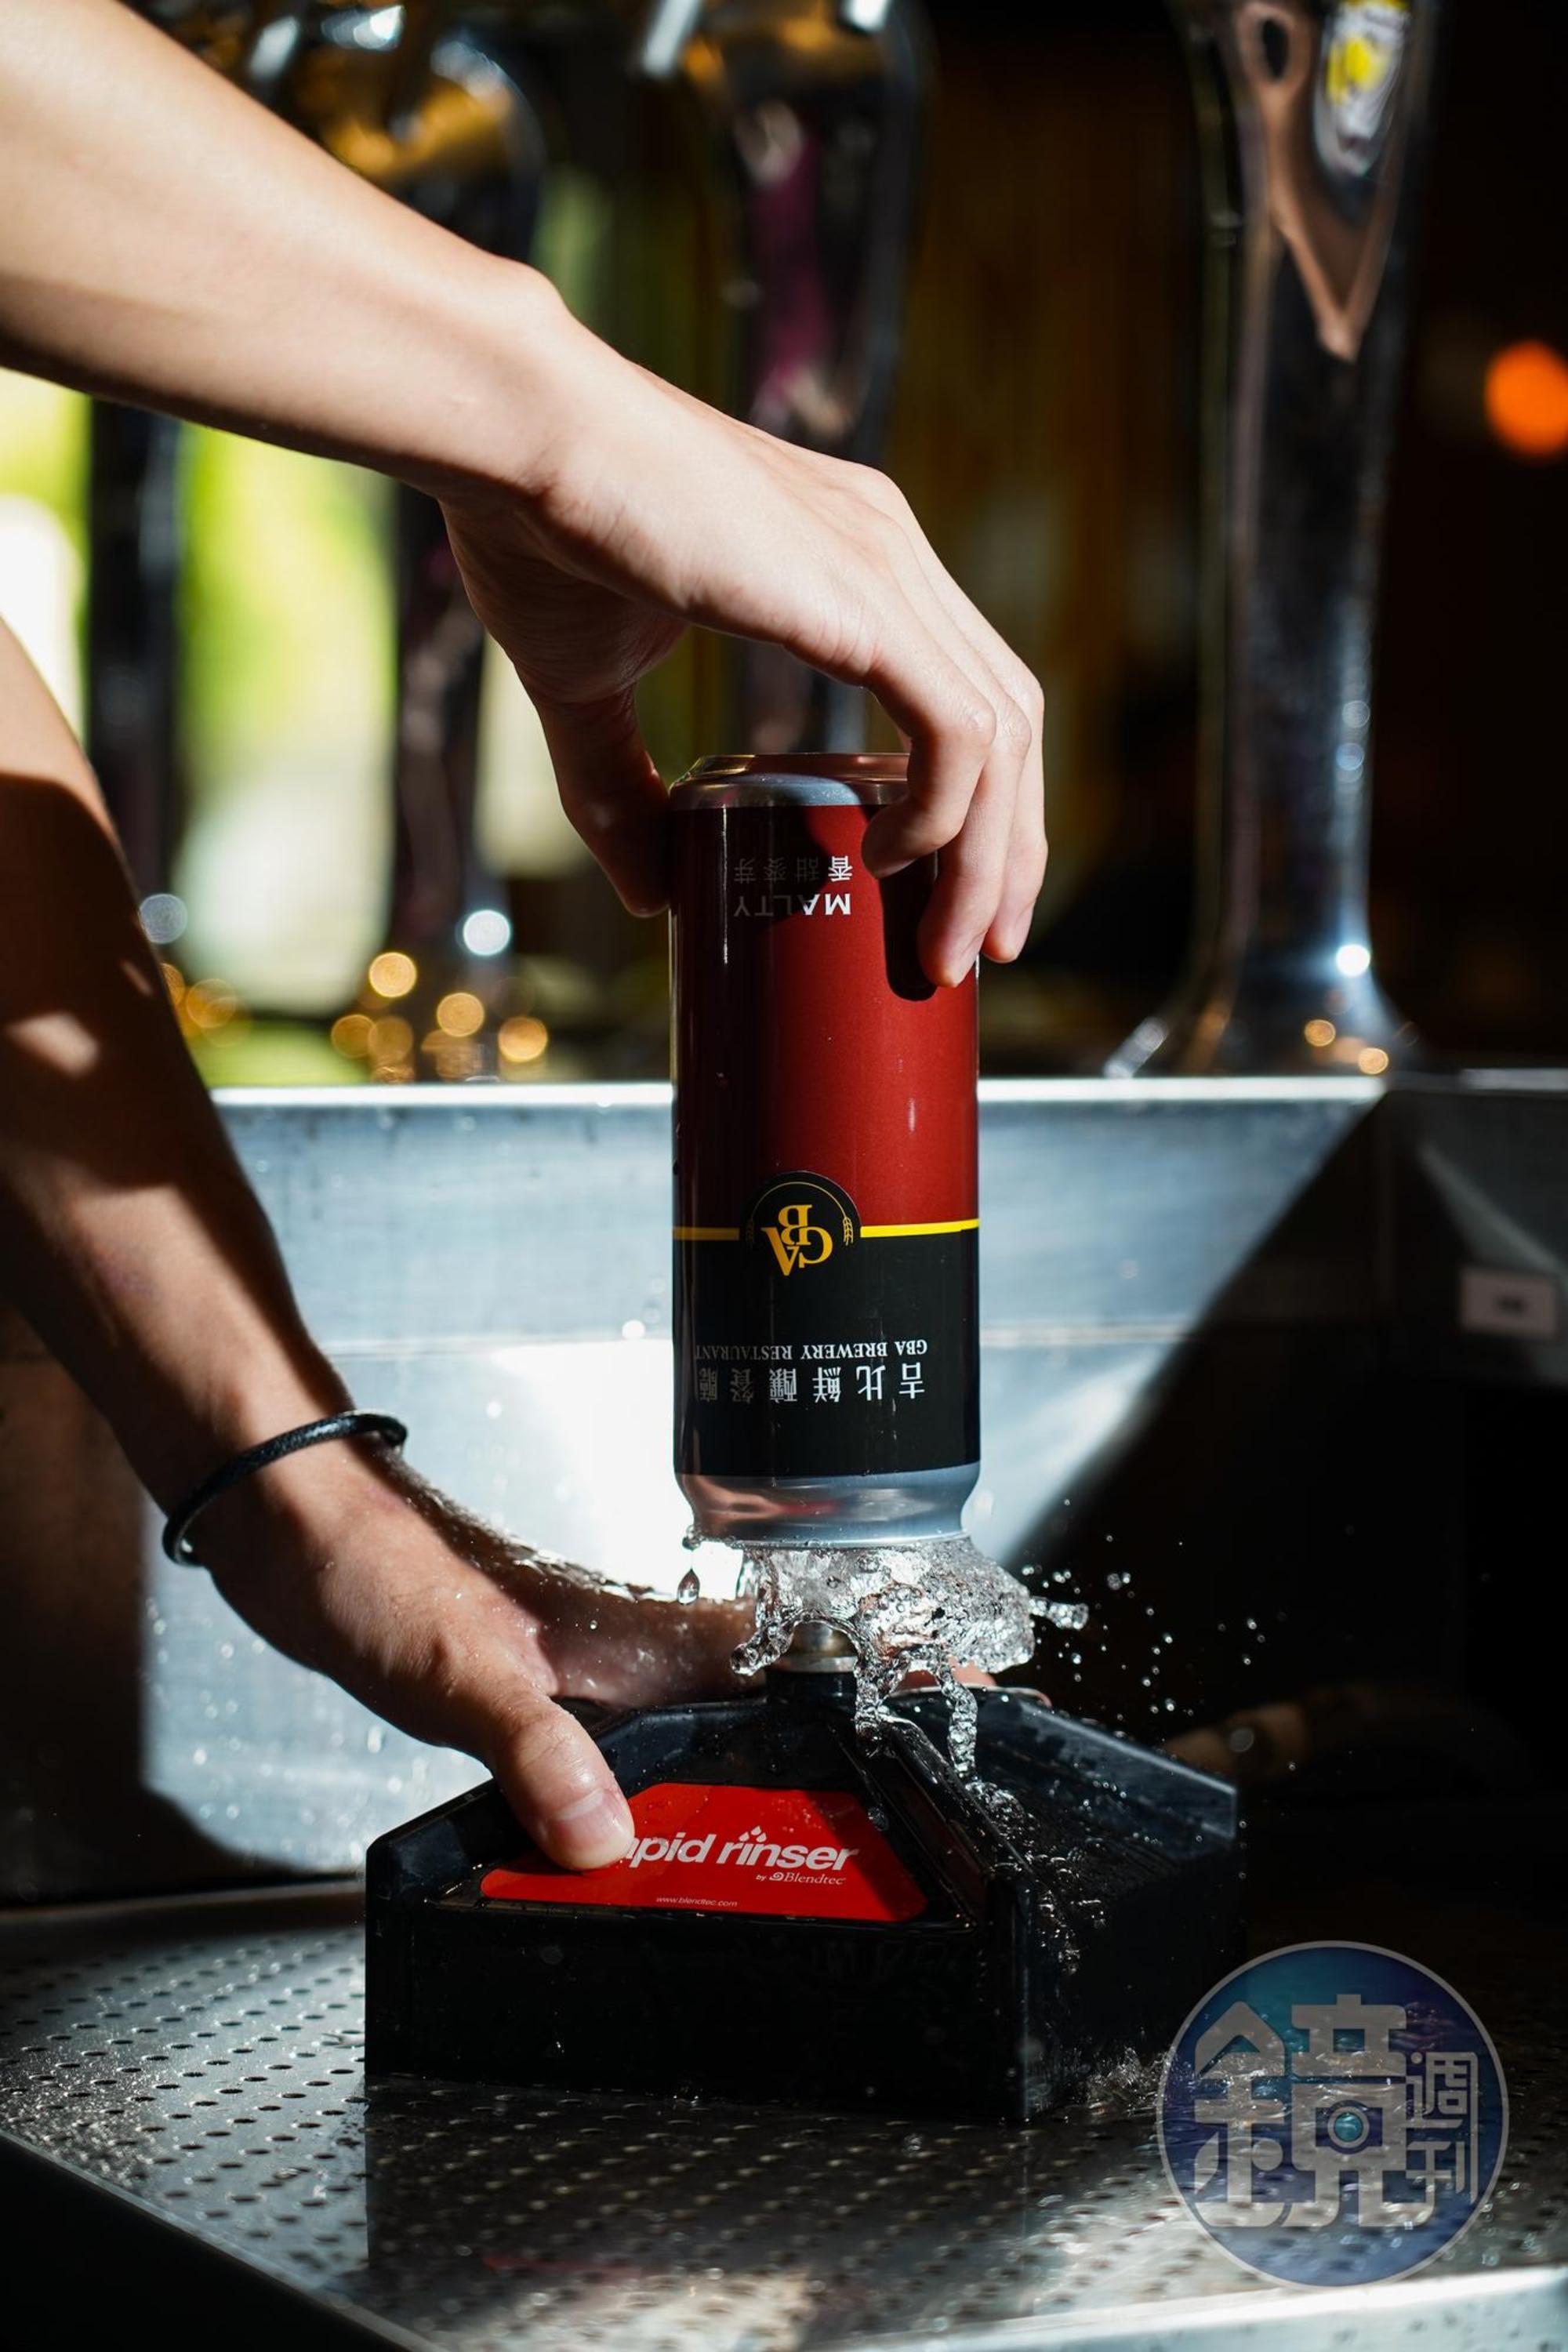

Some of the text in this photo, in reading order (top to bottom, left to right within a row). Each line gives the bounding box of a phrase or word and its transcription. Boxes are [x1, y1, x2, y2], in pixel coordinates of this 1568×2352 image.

[733, 855, 854, 883] 香甜麥芽
[733, 892, 852, 916] MALTY
[695, 1338, 928, 1361] GBA BREWERY RESTAURANT
[697, 1361, 925, 1405] 吉比鮮釀餐廳
[625, 1825, 861, 1871] pid rinser
[755, 1871, 846, 1886] by Blendtec
[655, 1896, 739, 1907] www.blendtec.com
